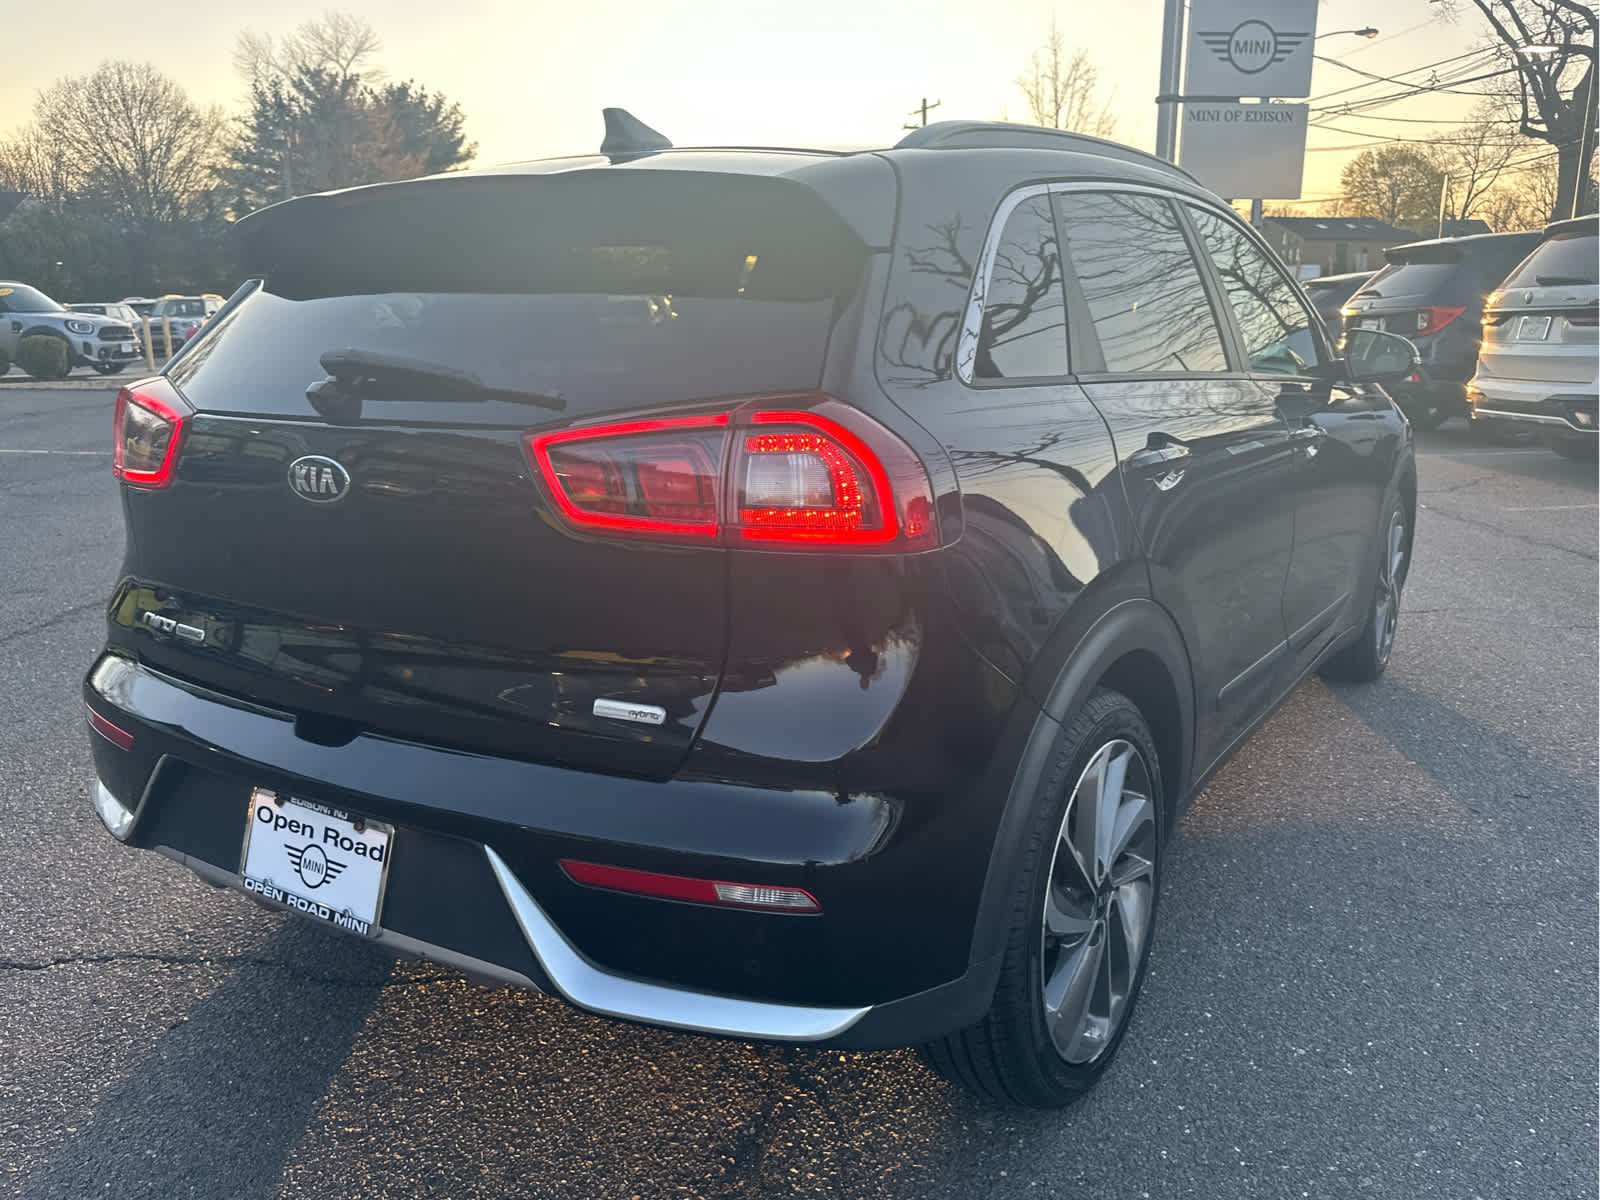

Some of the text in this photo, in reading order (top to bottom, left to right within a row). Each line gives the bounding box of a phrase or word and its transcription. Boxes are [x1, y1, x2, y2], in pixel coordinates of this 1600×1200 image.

[1234, 39, 1271, 55] MINI
[1188, 109, 1294, 123] MINI OF EDISON
[295, 464, 338, 494] KIA
[256, 805, 386, 863] Open Road
[302, 857, 325, 876] MINI
[243, 878, 369, 936] OPEN ROAD MINI
